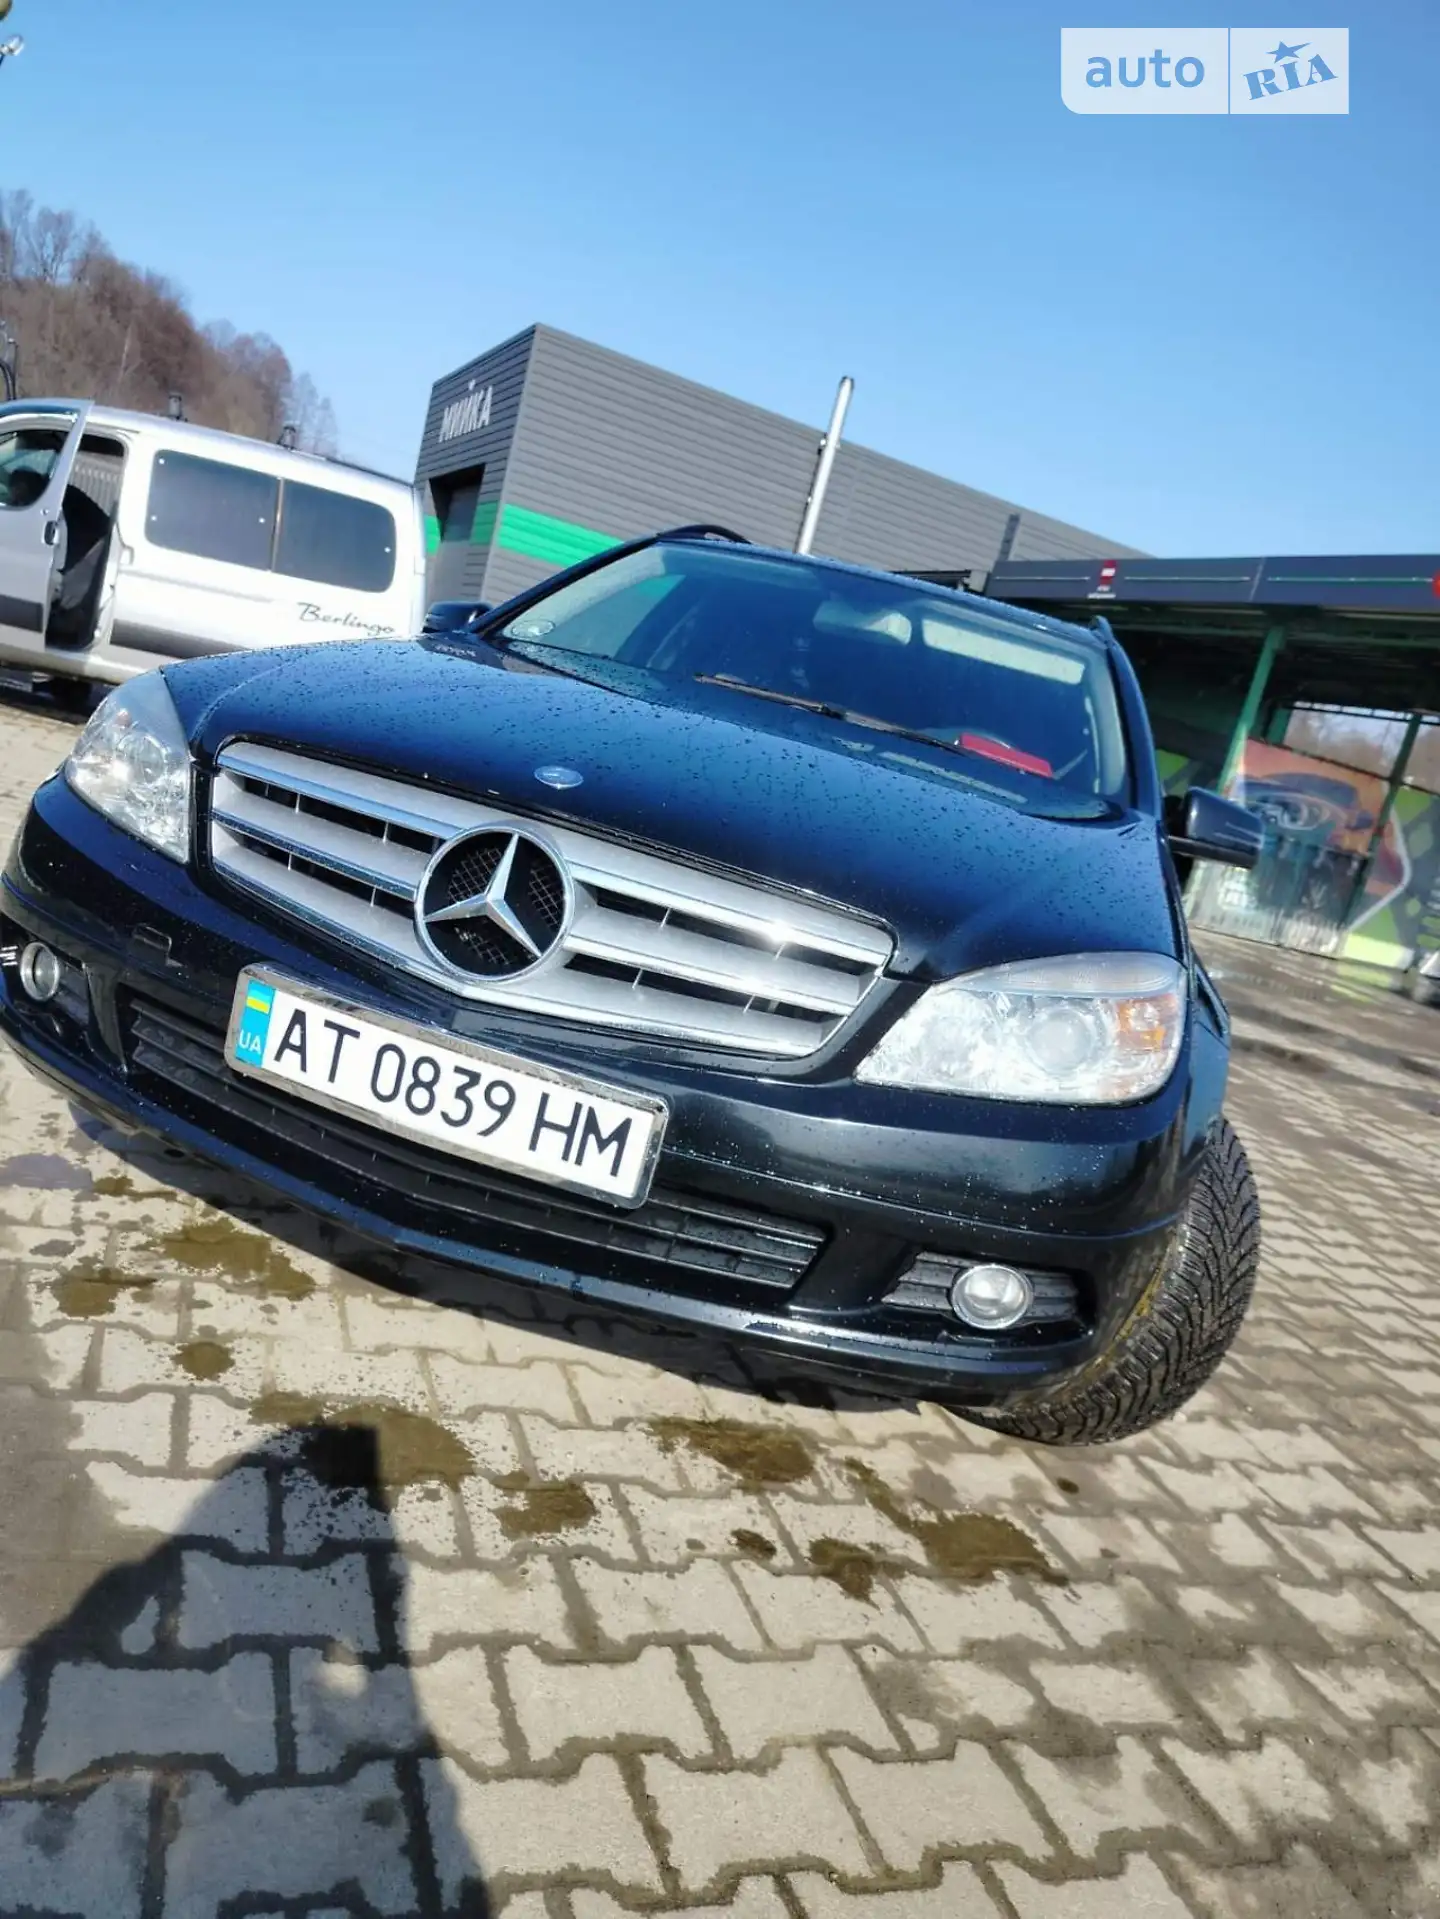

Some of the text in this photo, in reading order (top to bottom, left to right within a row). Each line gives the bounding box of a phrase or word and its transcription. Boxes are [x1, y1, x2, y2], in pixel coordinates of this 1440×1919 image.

[297, 601, 395, 636] Berlingo
[239, 1029, 262, 1055] UA
[274, 1008, 633, 1178] AT 0839 HM
